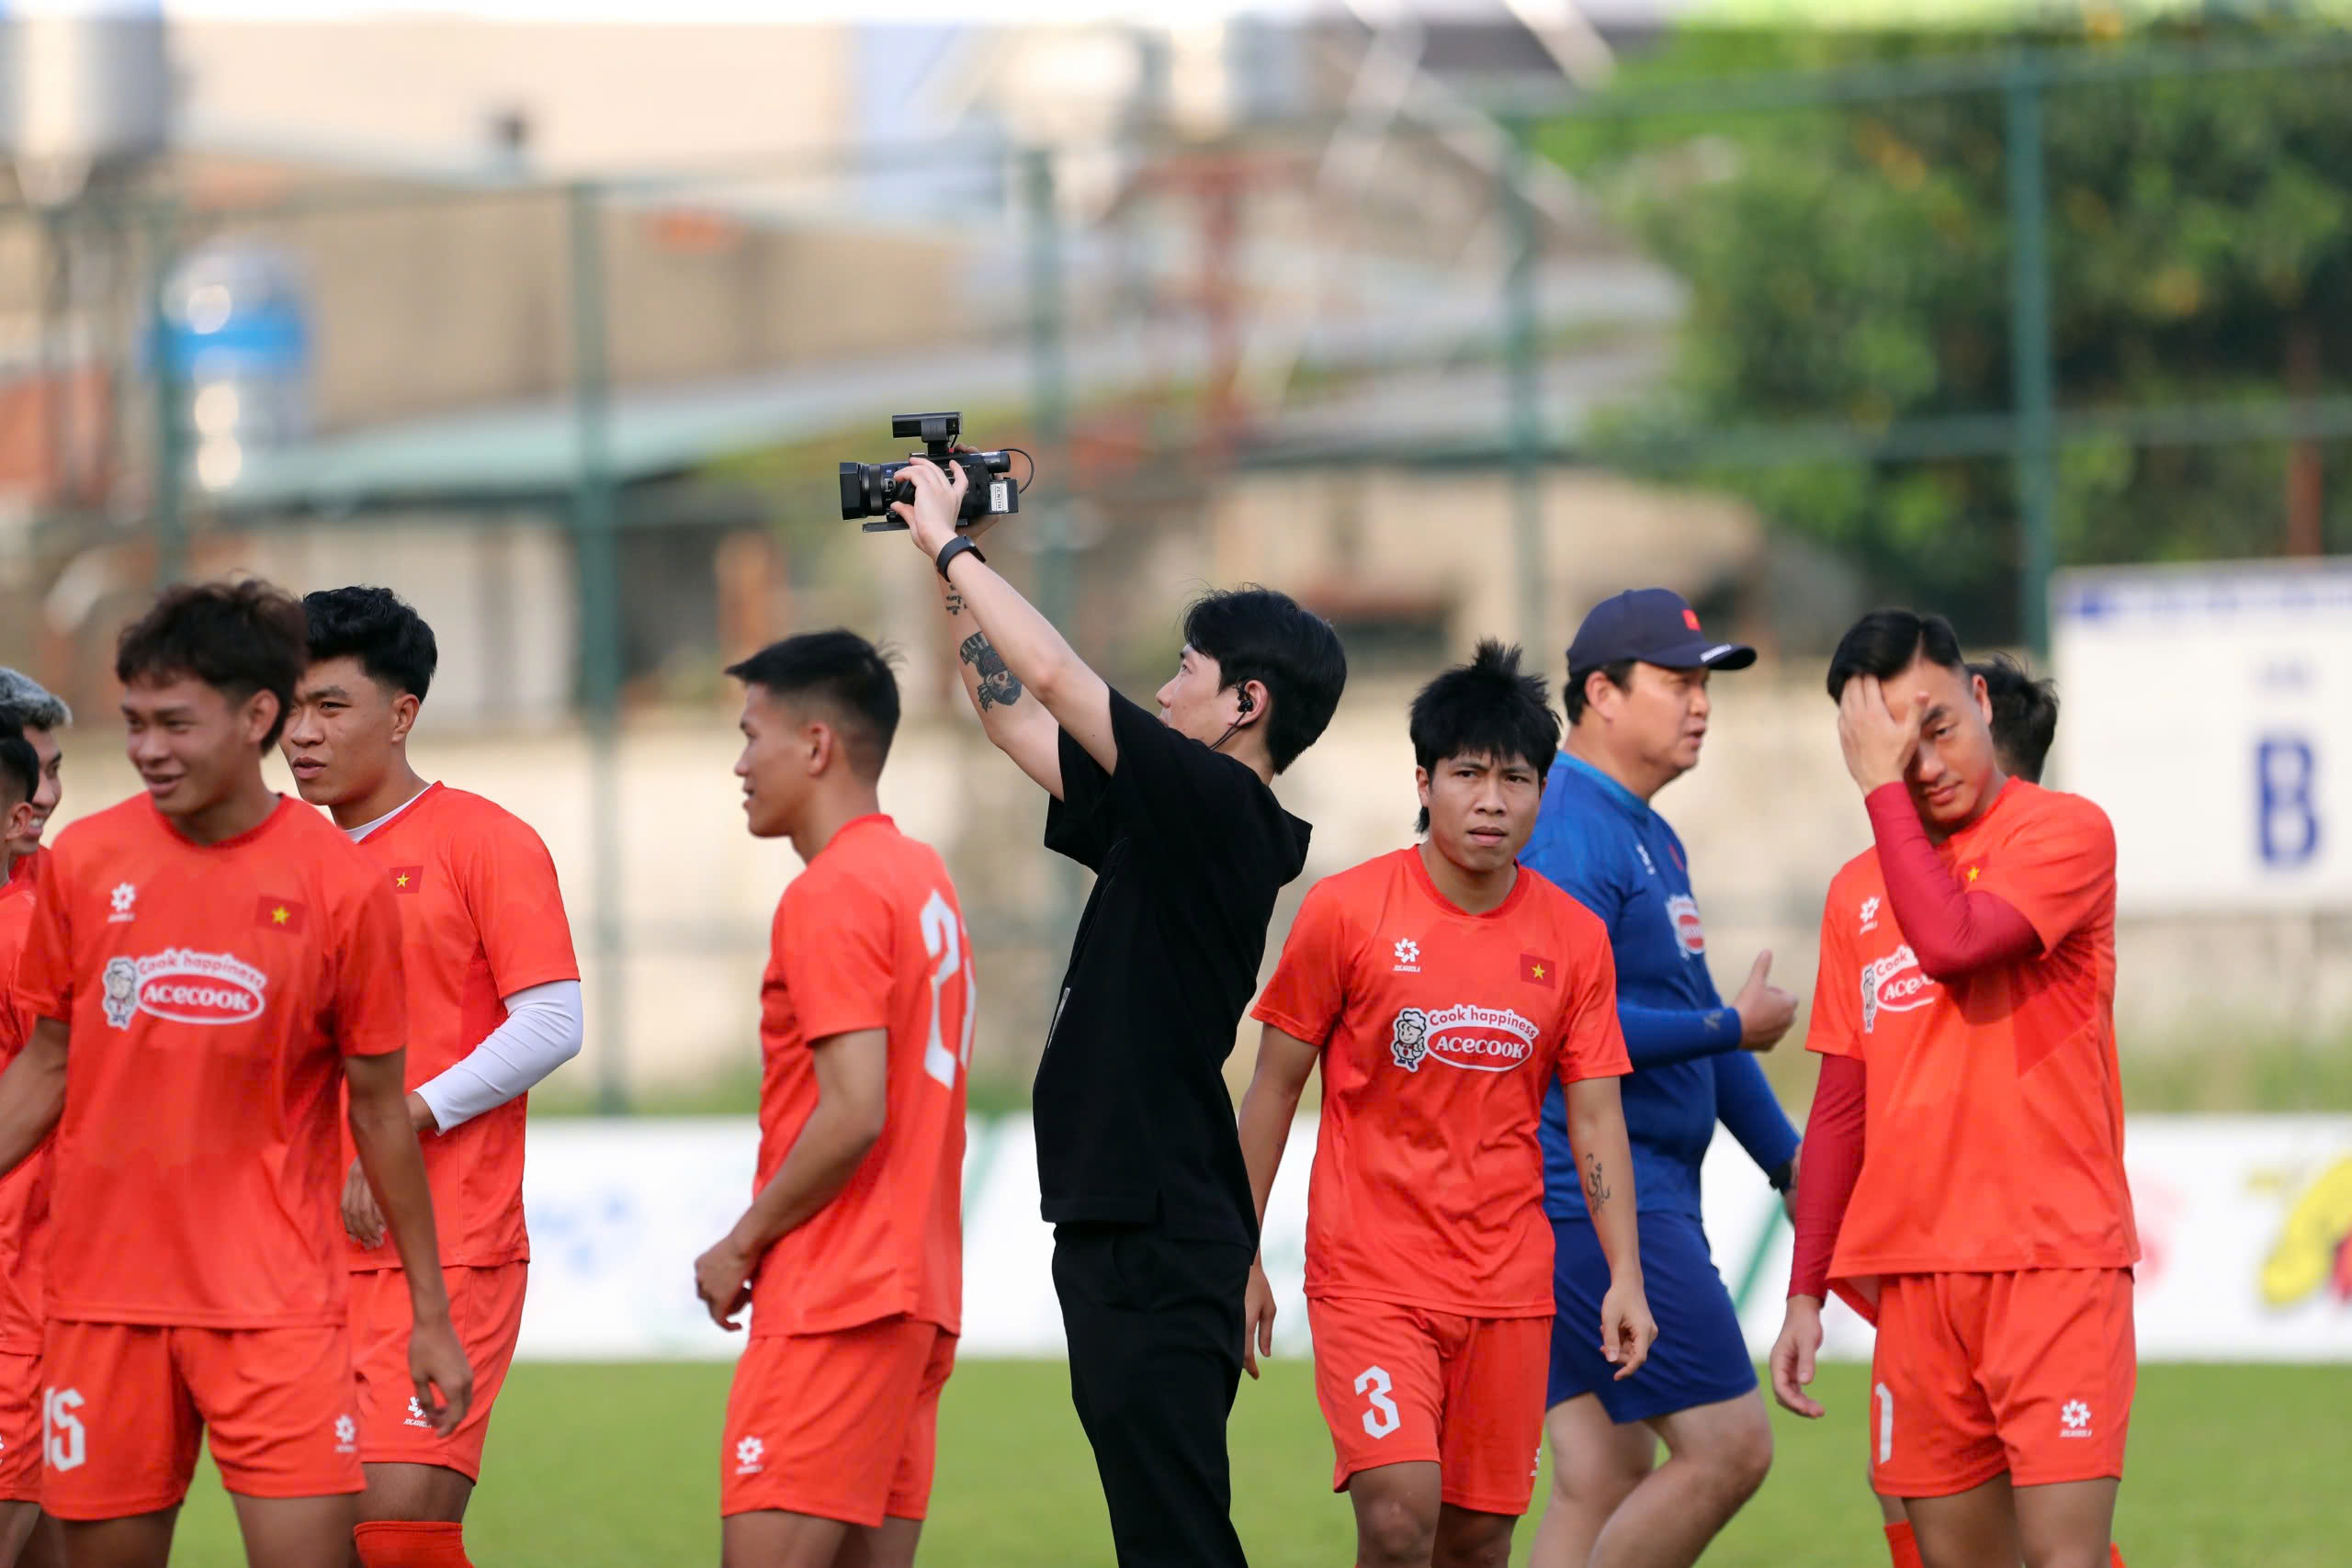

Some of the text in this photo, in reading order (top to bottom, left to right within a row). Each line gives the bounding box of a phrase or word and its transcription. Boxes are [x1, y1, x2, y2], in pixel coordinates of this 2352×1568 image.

[2256, 737, 2317, 863] B
[139, 954, 263, 987] Cook happiness
[1876, 952, 1908, 976] Cook
[1430, 1008, 1538, 1039] Cook happiness
[1353, 1364, 1402, 1440] 3
